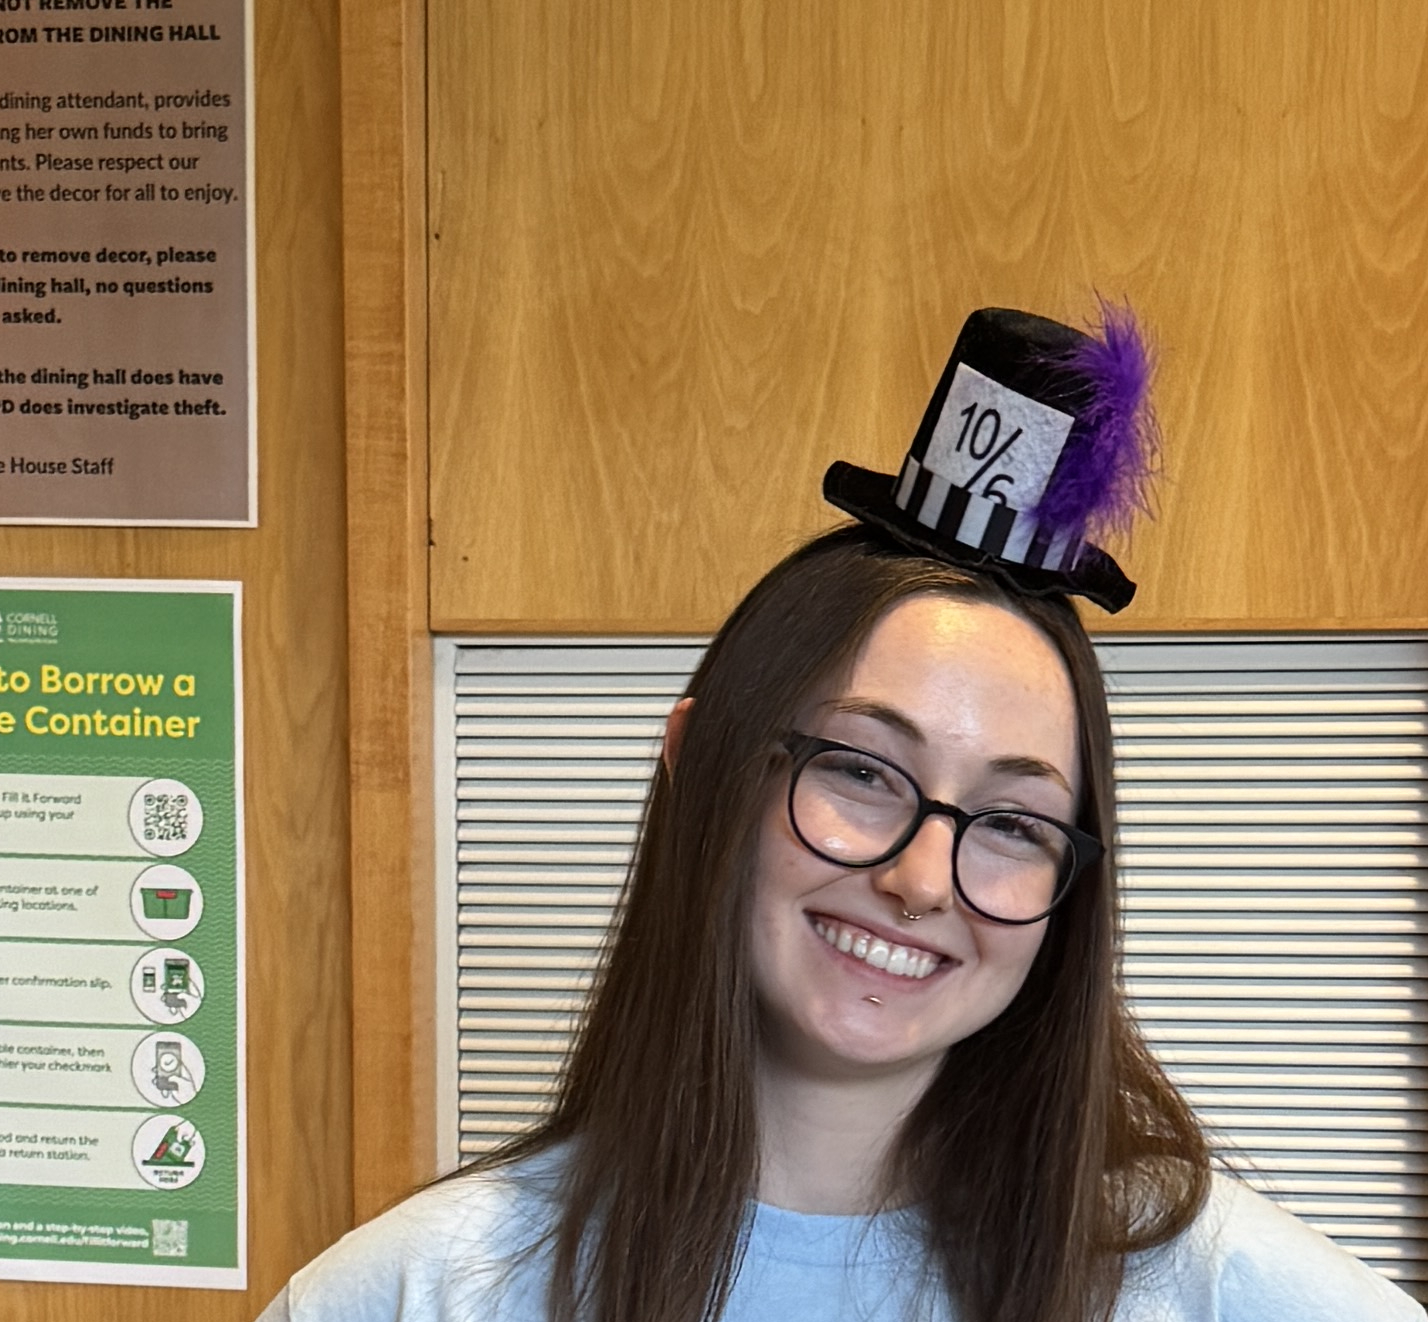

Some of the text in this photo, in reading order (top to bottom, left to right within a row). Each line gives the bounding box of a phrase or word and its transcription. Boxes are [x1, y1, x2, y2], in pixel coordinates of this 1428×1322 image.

[41, 26, 85, 43] THE
[89, 25, 164, 43] DINING
[168, 24, 221, 42] HALL
[56, 91, 150, 110] attendant,
[154, 89, 231, 111] provides
[25, 123, 56, 140] her
[58, 126, 99, 140] own
[103, 121, 153, 140] funds
[158, 122, 178, 140] to
[181, 120, 229, 142] bring
[35, 153, 94, 171] Please
[97, 153, 165, 173] respect
[168, 156, 201, 171] our
[15, 184, 45, 202] the
[48, 184, 101, 202] decor
[105, 183, 132, 202] for
[134, 183, 156, 201] all
[159, 185, 180, 201] to
[184, 183, 238, 205] enjoy.
[21, 250, 91, 263] remove
[95, 247, 153, 266] decor,
[156, 246, 217, 267] please
[50, 277, 91, 296] hall,
[95, 281, 119, 294] no
[122, 277, 214, 297] questions
[1, 307, 62, 324] asked.
[30, 367, 90, 390] dining
[92, 368, 127, 385] hall
[130, 369, 175, 385] does
[178, 369, 224, 385] have
[19, 398, 64, 415] does
[67, 398, 170, 420] investigate
[173, 398, 227, 416] theft.
[10, 456, 68, 475] House
[70, 457, 114, 475] Staff
[6, 613, 58, 624] CORNELL
[7, 625, 58, 637] DINING
[40, 664, 165, 695] Borrow
[173, 674, 196, 697] a
[24, 706, 201, 737] Container
[11, 975, 88, 988] confirmation
[89, 977, 113, 991] slip.
